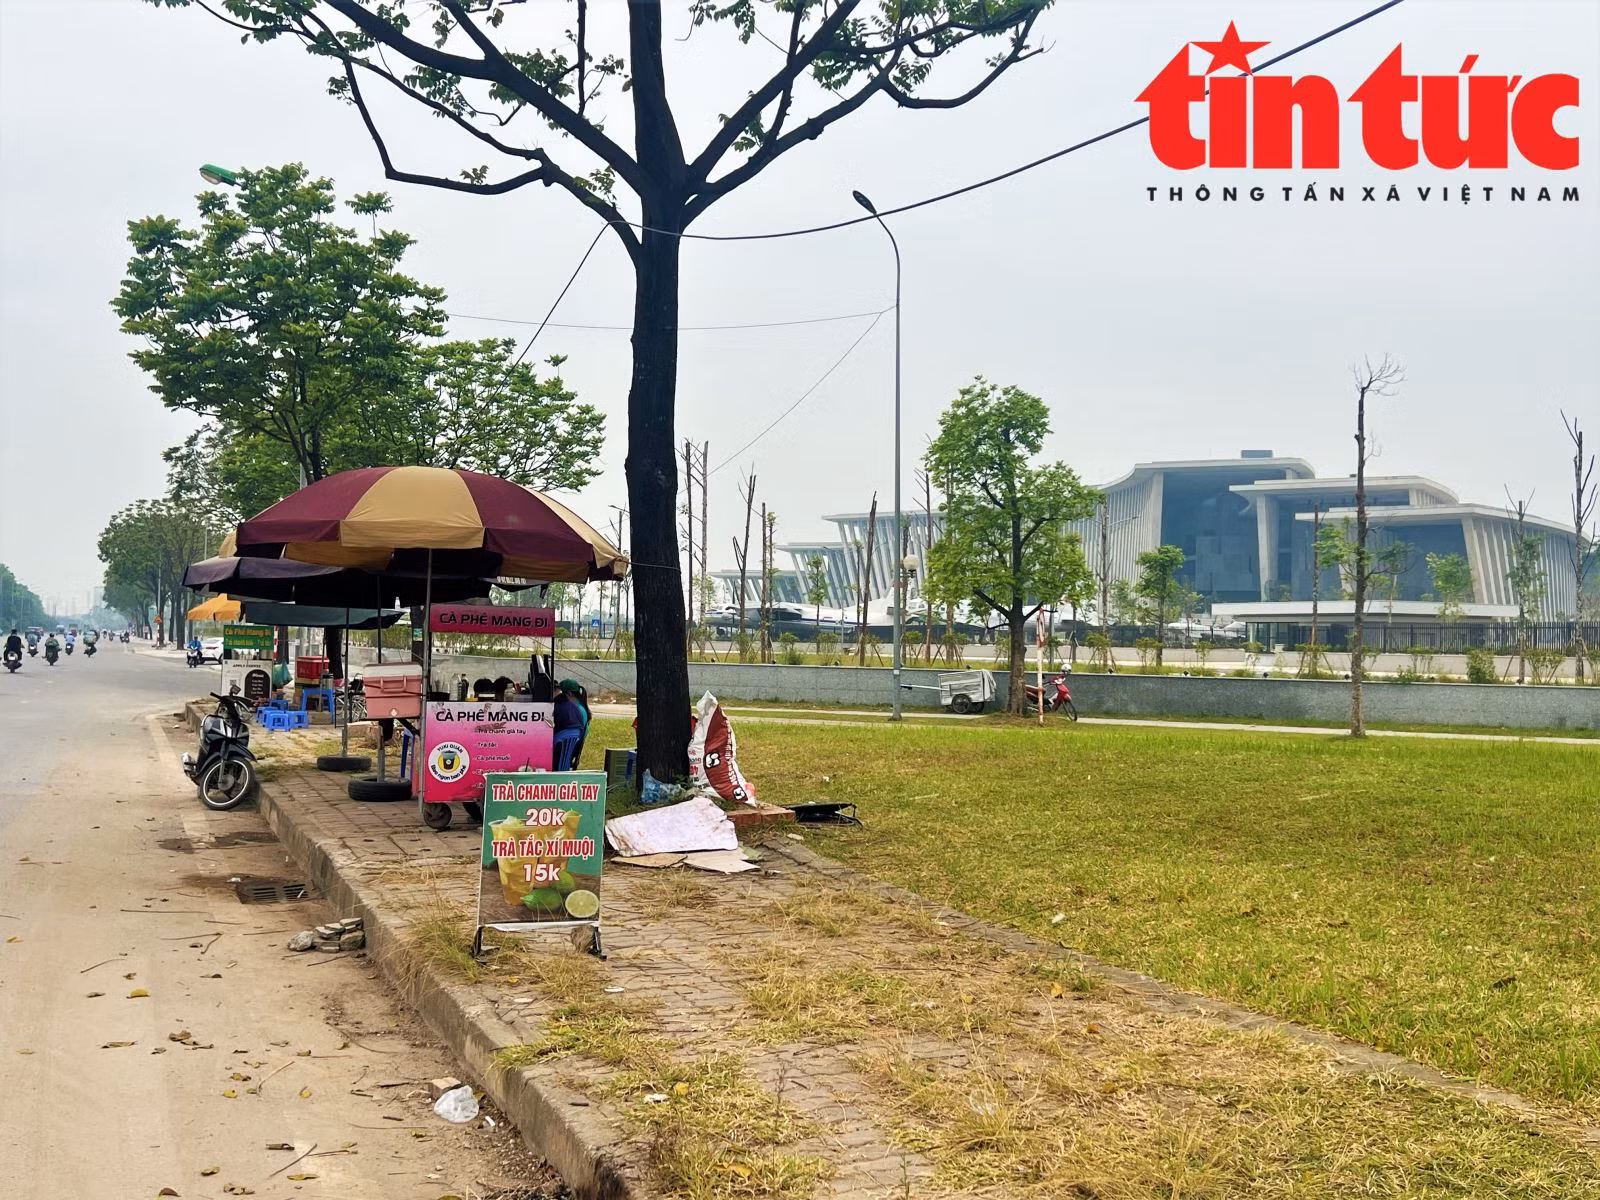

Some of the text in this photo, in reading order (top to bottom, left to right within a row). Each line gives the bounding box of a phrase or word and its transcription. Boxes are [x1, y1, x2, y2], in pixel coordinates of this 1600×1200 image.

[439, 611, 548, 629] CÀ PHÊ MANG ĐI
[435, 708, 454, 722] CÀ
[457, 708, 485, 722] PHÊ
[488, 711, 528, 722] MANG
[492, 781, 515, 801] TRÀ
[517, 784, 556, 801] CHANH
[581, 784, 600, 801] TAY
[525, 808, 566, 827] 20k
[492, 835, 594, 861] TRÀ TẮC XÍ MUỘI
[523, 863, 561, 882] 15k
